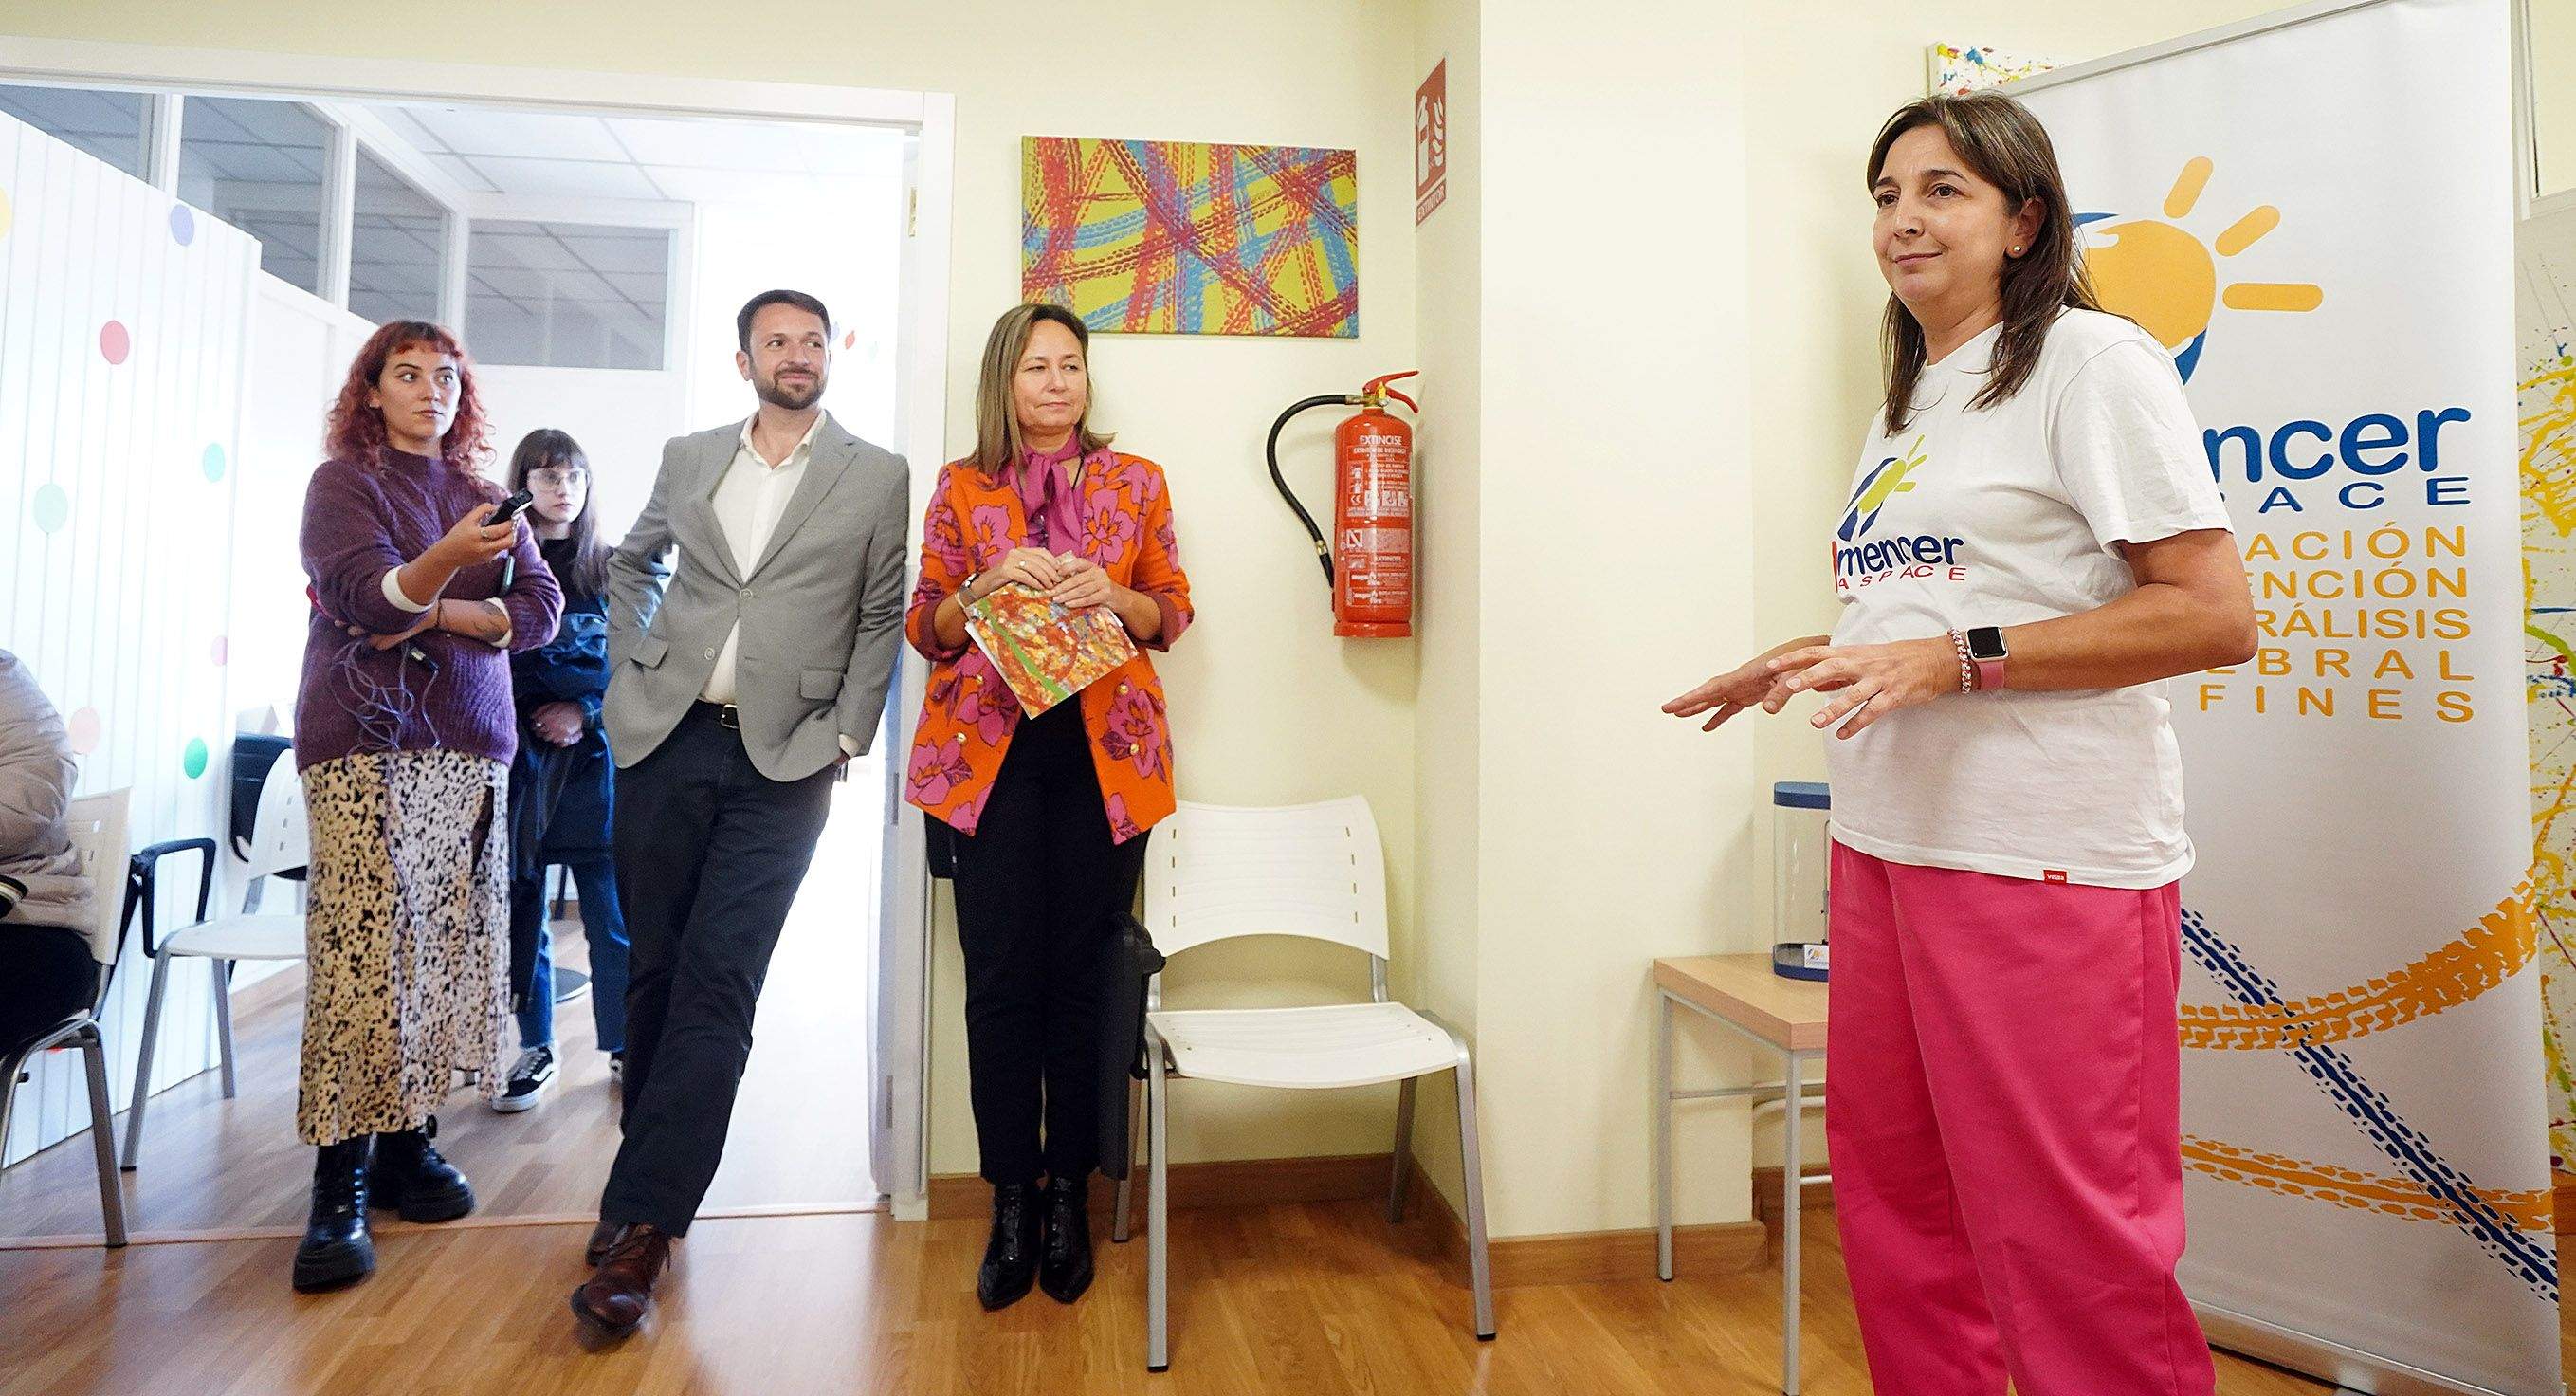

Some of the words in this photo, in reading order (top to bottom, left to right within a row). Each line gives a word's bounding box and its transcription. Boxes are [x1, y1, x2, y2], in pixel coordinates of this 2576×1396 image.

[2202, 407, 2472, 484] ncer
[2220, 476, 2472, 514] ACE
[2244, 521, 2466, 562] ACIÓN
[2245, 560, 2467, 600] NCIÓN
[2256, 602, 2472, 640] RÁLISIS
[2206, 648, 2475, 681] BRAL
[2199, 684, 2475, 724] FINES
